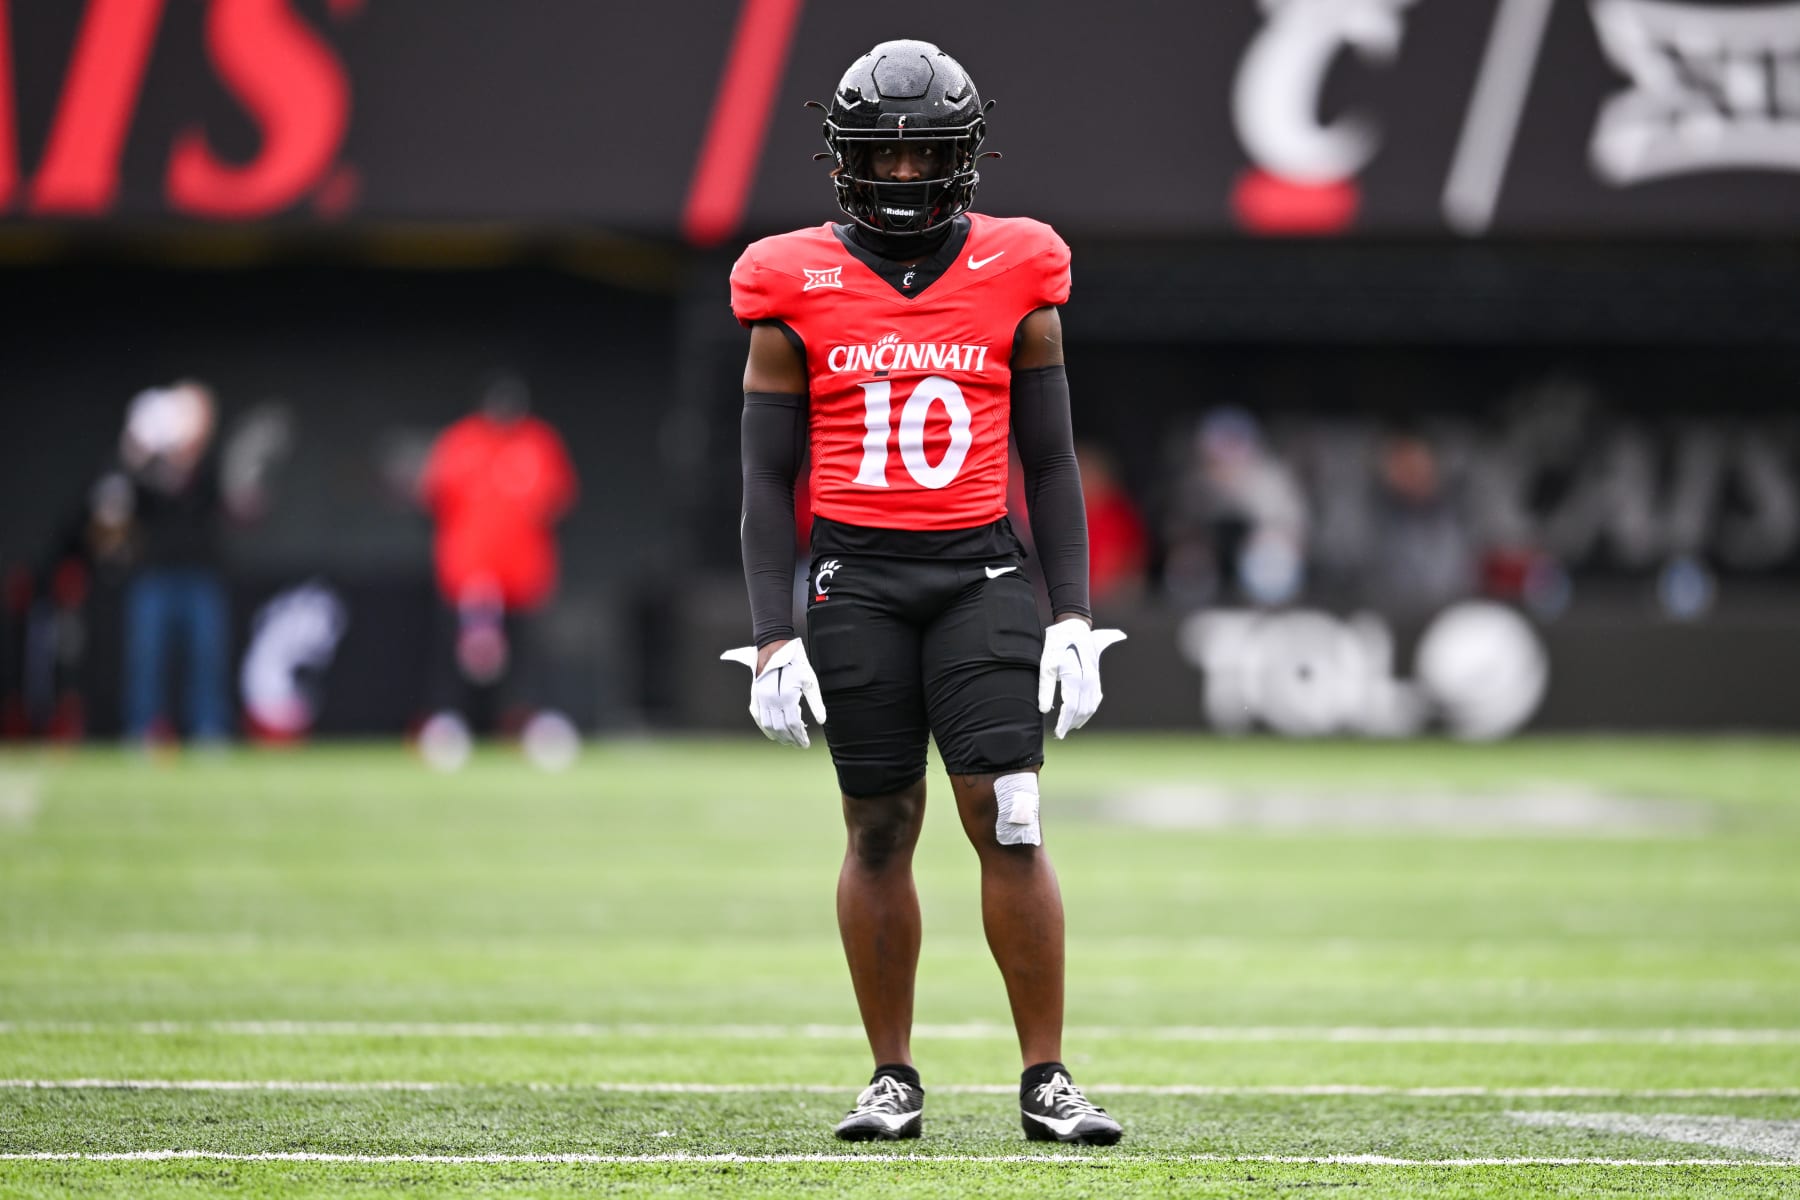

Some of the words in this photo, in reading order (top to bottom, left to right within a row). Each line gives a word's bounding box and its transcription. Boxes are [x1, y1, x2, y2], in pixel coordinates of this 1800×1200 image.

[887, 207, 914, 217] Riddell
[828, 341, 988, 372] CINCINNATI
[852, 376, 973, 489] 10
